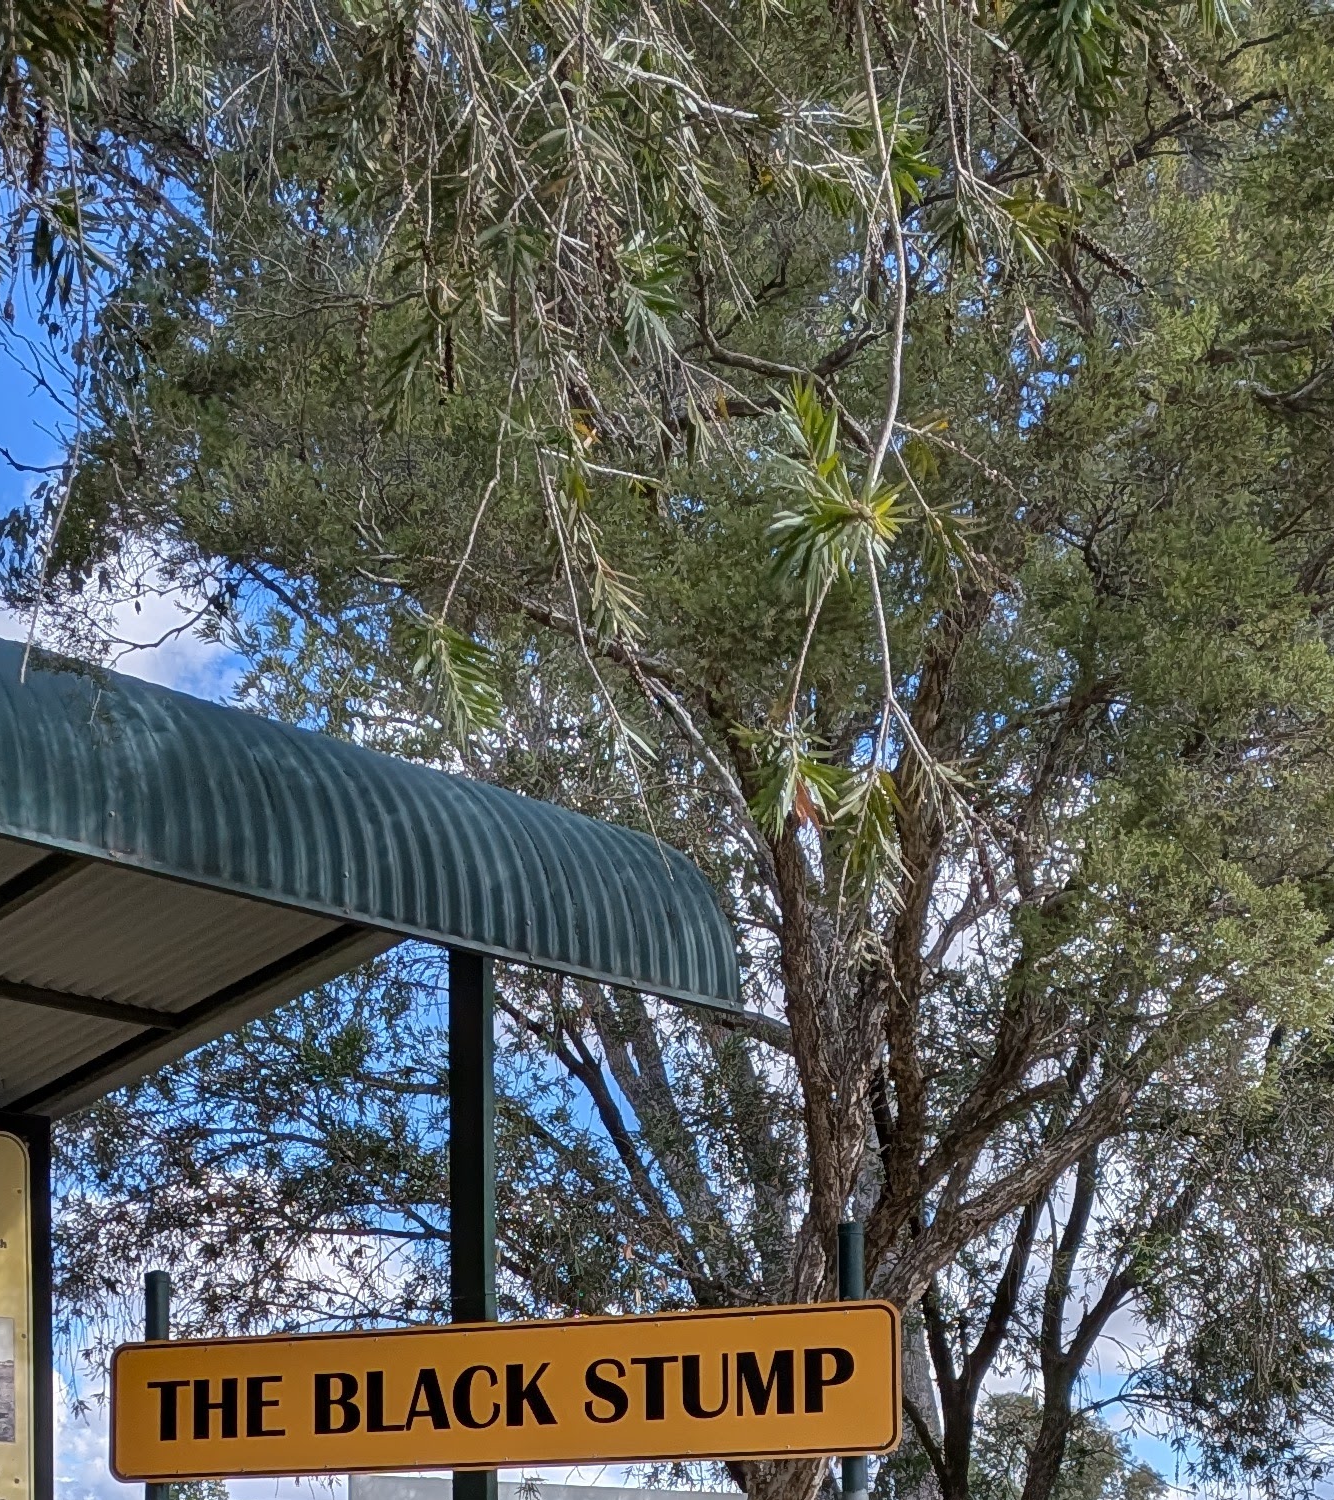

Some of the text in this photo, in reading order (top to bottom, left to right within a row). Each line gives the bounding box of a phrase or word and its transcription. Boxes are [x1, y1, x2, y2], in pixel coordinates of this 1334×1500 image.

[147, 1348, 854, 1441] THE BLACK STUMP
